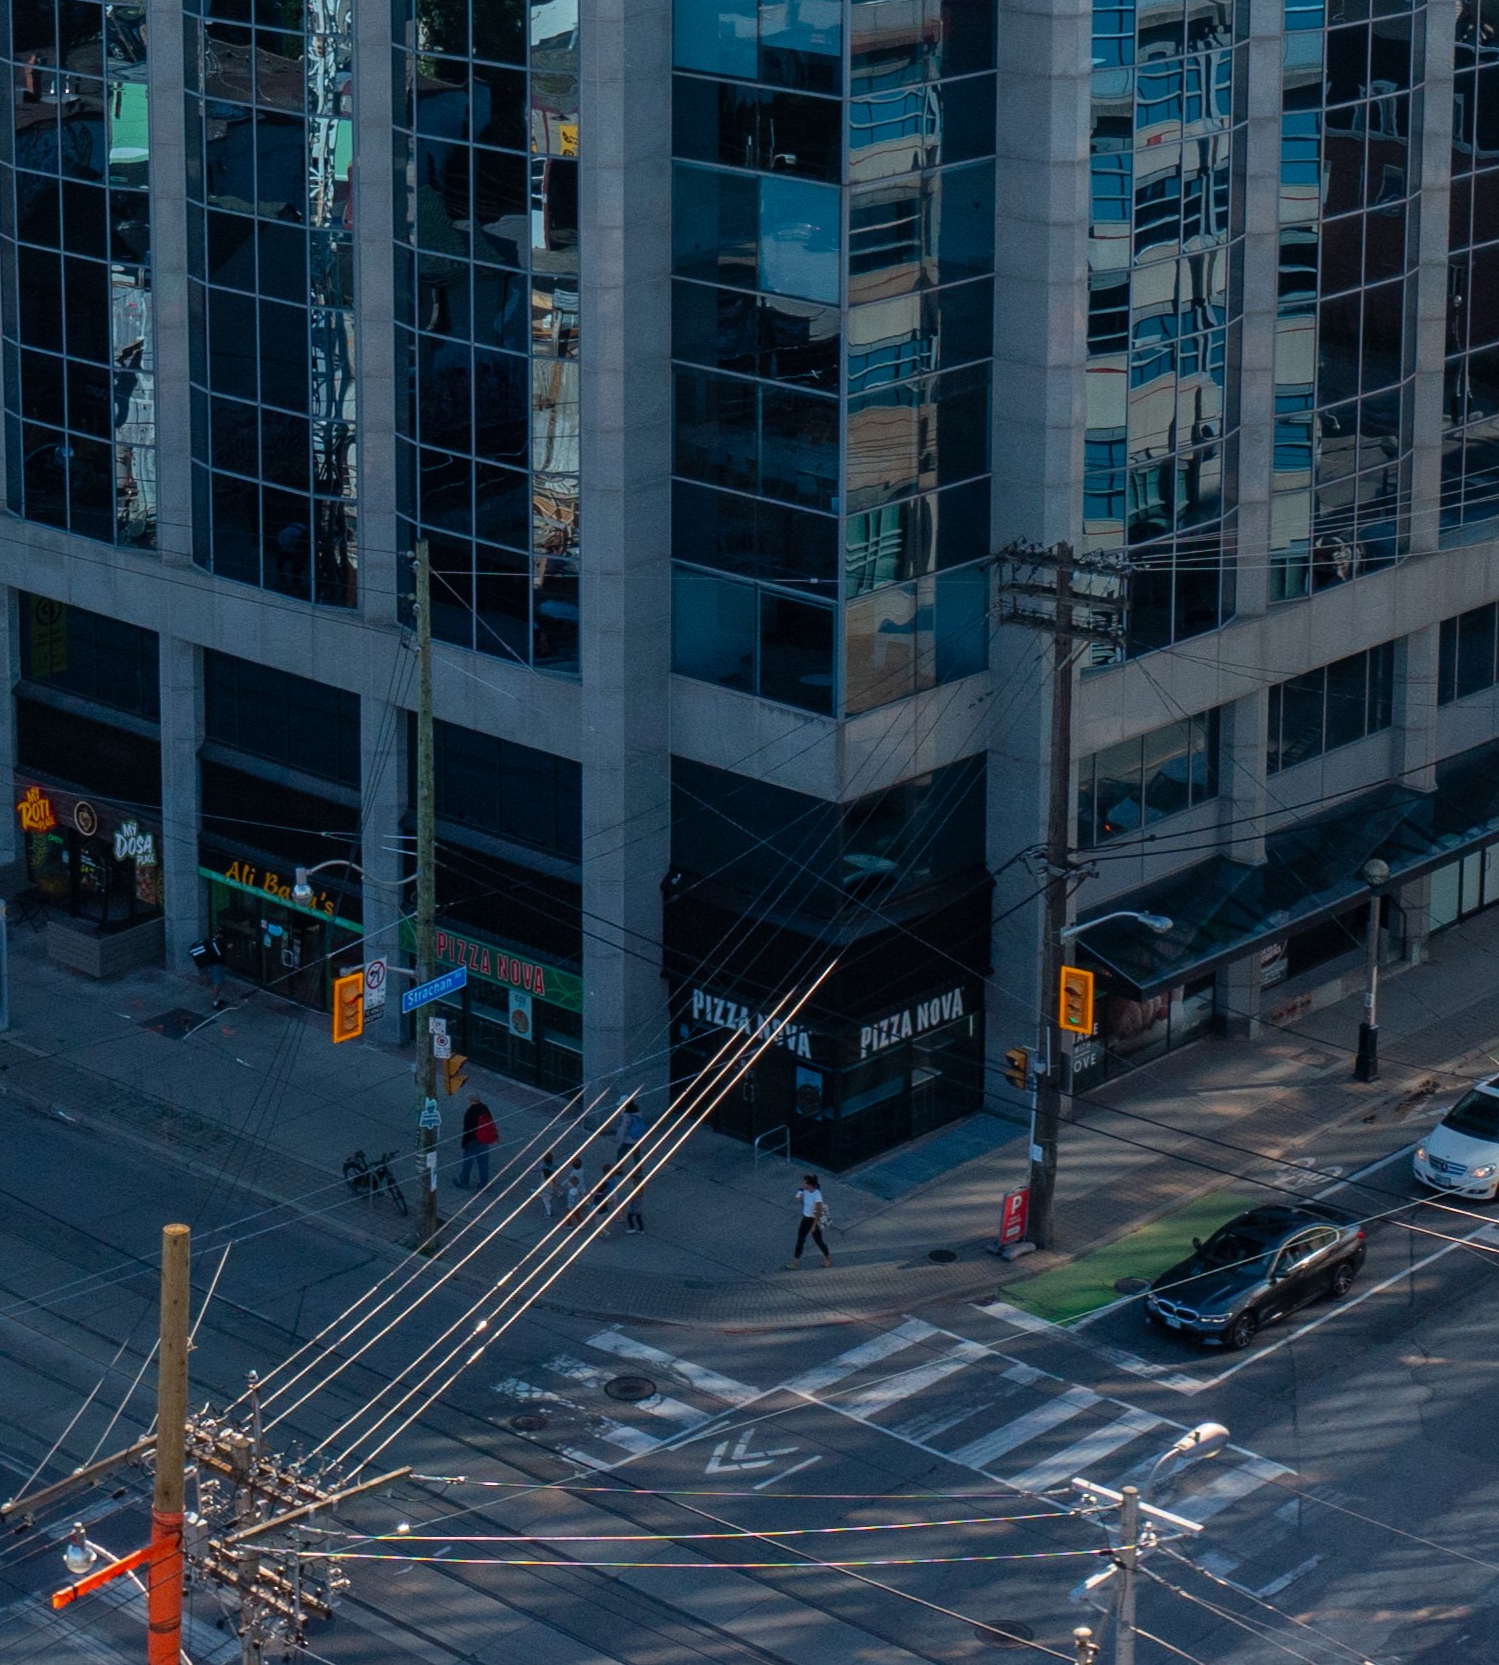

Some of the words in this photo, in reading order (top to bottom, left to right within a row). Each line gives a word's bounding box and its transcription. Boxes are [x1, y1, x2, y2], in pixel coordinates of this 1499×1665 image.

[26, 787, 41, 803] MY
[17, 799, 50, 830] ROTI
[122, 821, 138, 837] MY
[114, 834, 154, 860] DOSA
[225, 861, 256, 886] Ali
[263, 872, 334, 917] Baa's
[436, 931, 491, 975] PIZZA
[497, 954, 546, 996] NOVA
[407, 977, 452, 1006] Strachan
[692, 988, 752, 1036] PIZZA
[756, 1012, 812, 1060] NOVA
[860, 1009, 913, 1059] PIZZA
[917, 987, 964, 1032] NOVA
[1011, 1195, 1023, 1215] P
